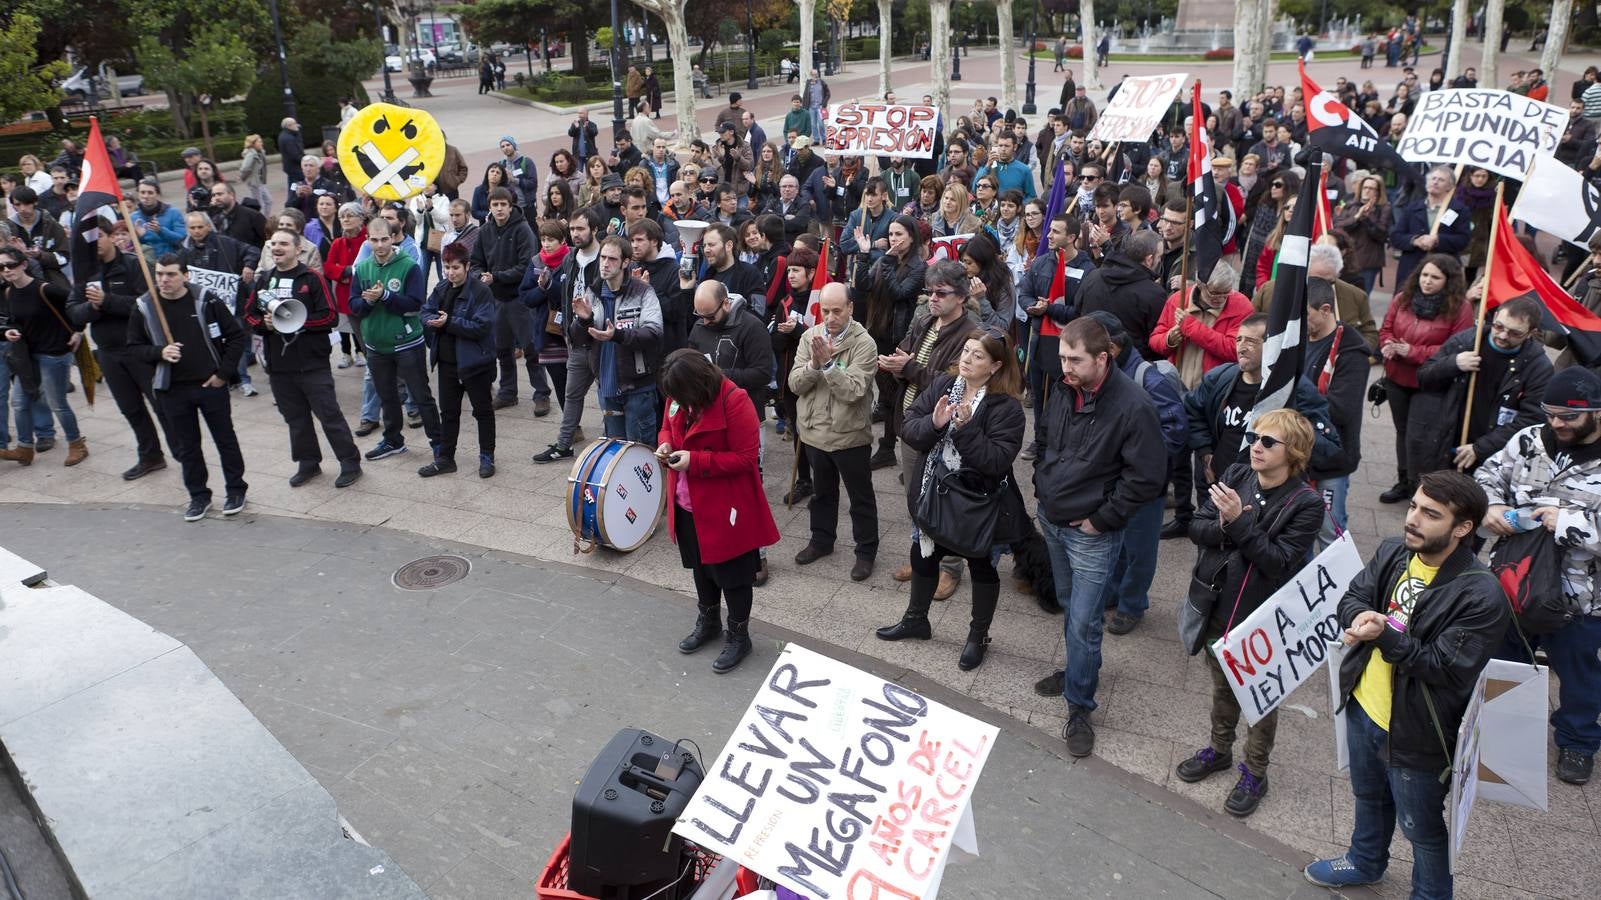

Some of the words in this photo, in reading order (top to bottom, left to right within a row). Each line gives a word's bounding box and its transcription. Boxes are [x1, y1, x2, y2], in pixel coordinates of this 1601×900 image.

[836, 104, 935, 128] STOP
[1112, 77, 1177, 109] STOP
[1423, 92, 1512, 111] BASTA
[1523, 101, 1565, 127] DE
[1345, 134, 1378, 152] AIT
[584, 488, 595, 504] CNT
[1222, 627, 1273, 687] NO
[1274, 606, 1296, 646] A
[1296, 564, 1338, 613] LA
[1250, 664, 1285, 715] LEY
[690, 663, 831, 845] LLEVAR
[776, 737, 836, 804] UN
[777, 683, 928, 899] MEGAFONO
[869, 780, 921, 866] AÑOS
[907, 730, 942, 776] DE
[904, 735, 988, 881] CARCEL
